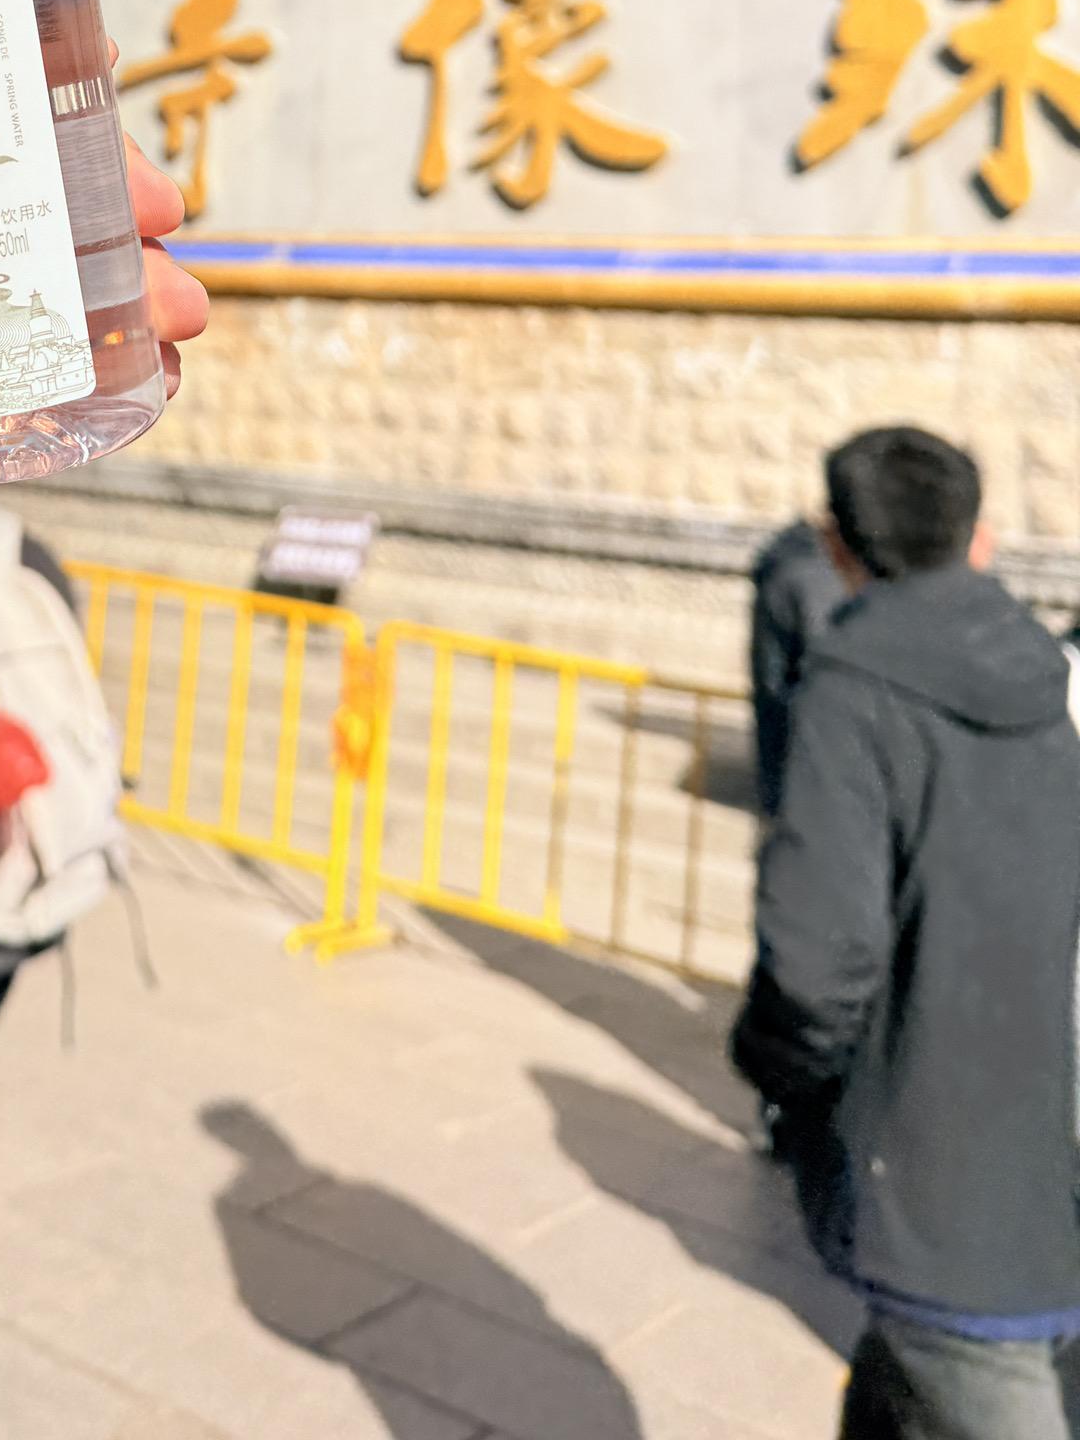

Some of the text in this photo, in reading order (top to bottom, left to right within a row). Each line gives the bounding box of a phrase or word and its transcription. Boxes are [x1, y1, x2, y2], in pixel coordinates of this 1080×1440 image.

[0, 48, 10, 61] DE
[4, 72, 18, 112] SPRING
[10, 112, 24, 148] WATER
